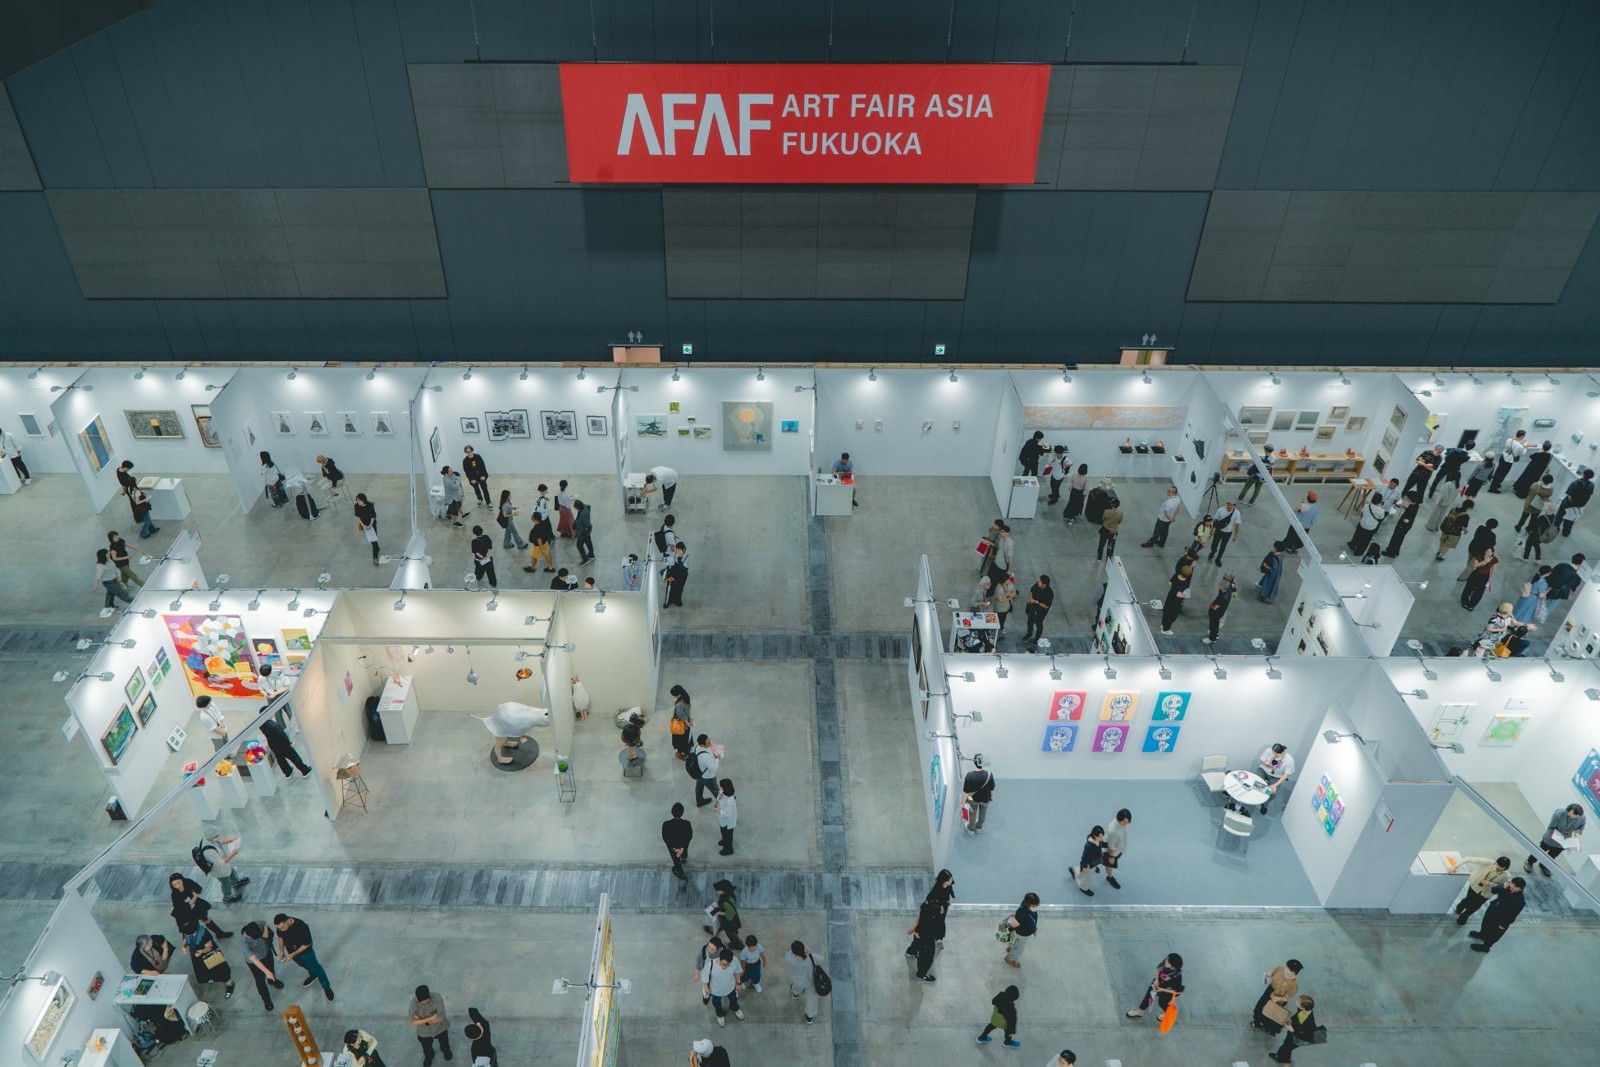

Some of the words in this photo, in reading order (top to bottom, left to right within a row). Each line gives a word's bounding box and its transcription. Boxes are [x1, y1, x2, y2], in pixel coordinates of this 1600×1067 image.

[782, 94, 840, 117] ART
[851, 94, 915, 117] FAIR
[925, 94, 993, 118] ASIA
[783, 132, 922, 155] FUKUOKA
